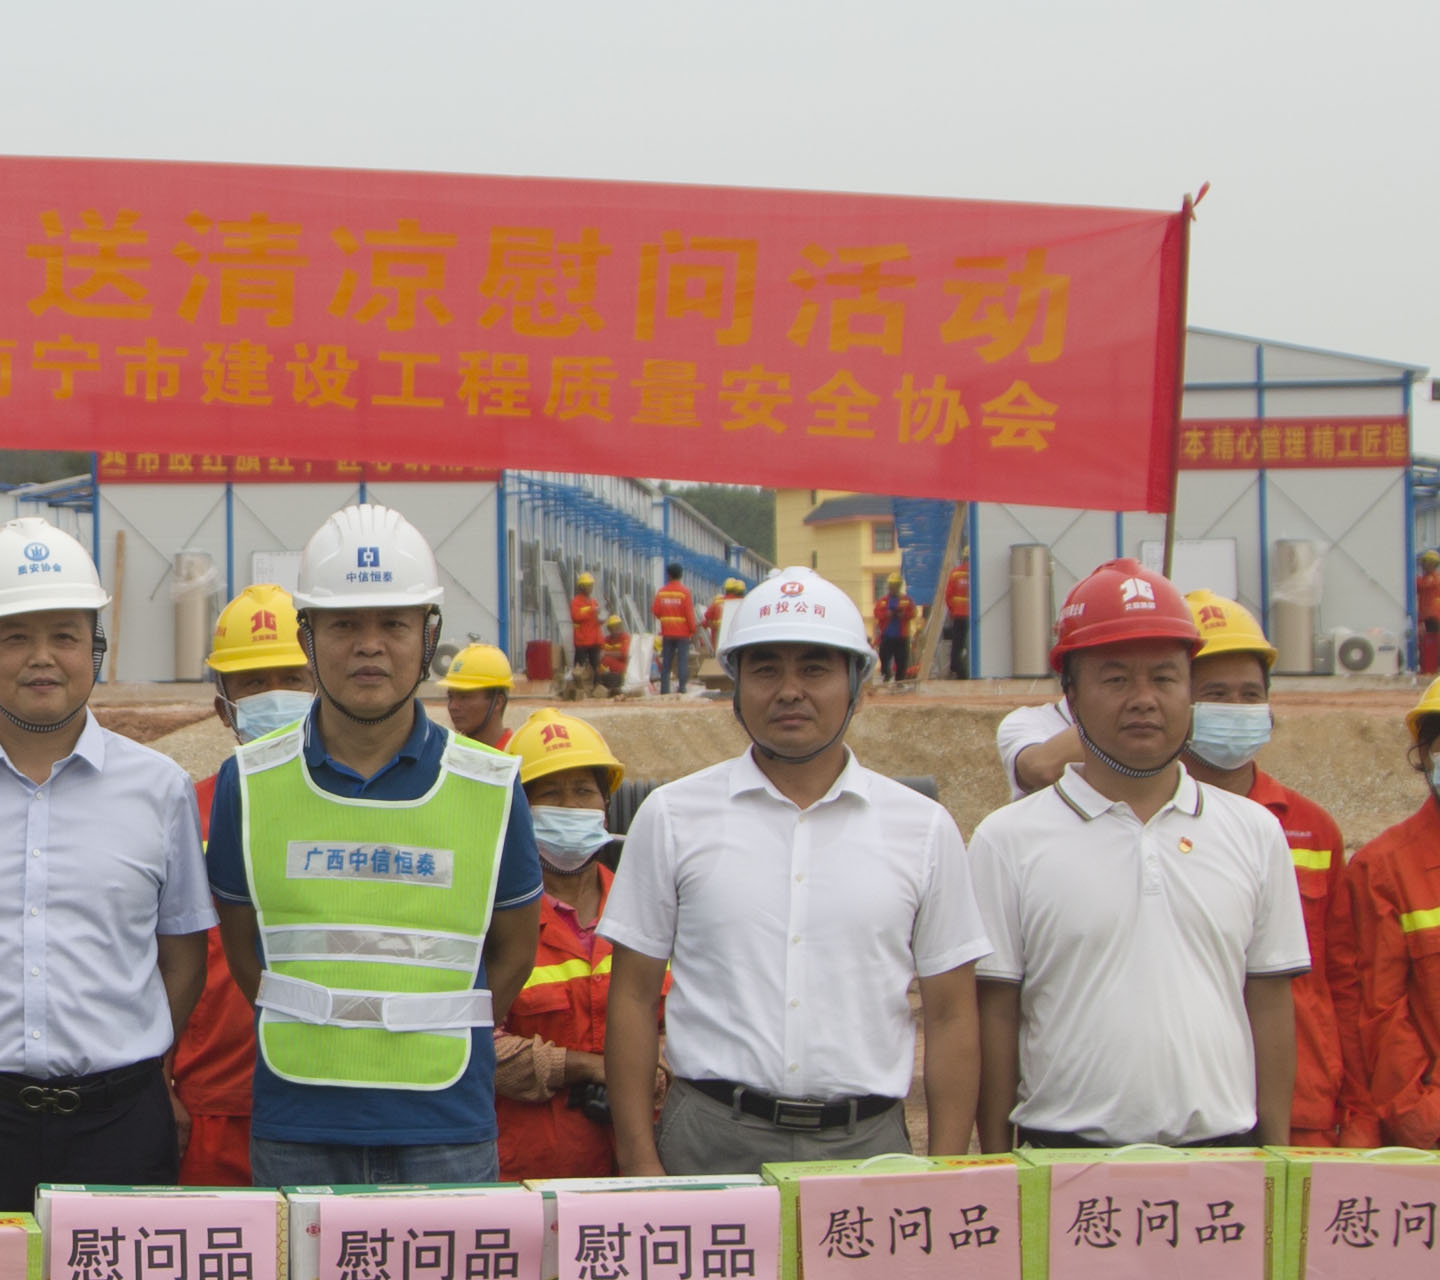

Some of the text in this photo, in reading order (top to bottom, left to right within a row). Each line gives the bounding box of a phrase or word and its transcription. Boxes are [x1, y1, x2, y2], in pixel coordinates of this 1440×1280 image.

[345, 570, 394, 584] 中信恒泰
[758, 601, 827, 619] 南投公司
[303, 849, 437, 878] 广西中信恒泰
[819, 1205, 999, 1258] 慰问品
[1067, 1196, 1245, 1248] 慰问品
[575, 1223, 754, 1280] 慰问品
